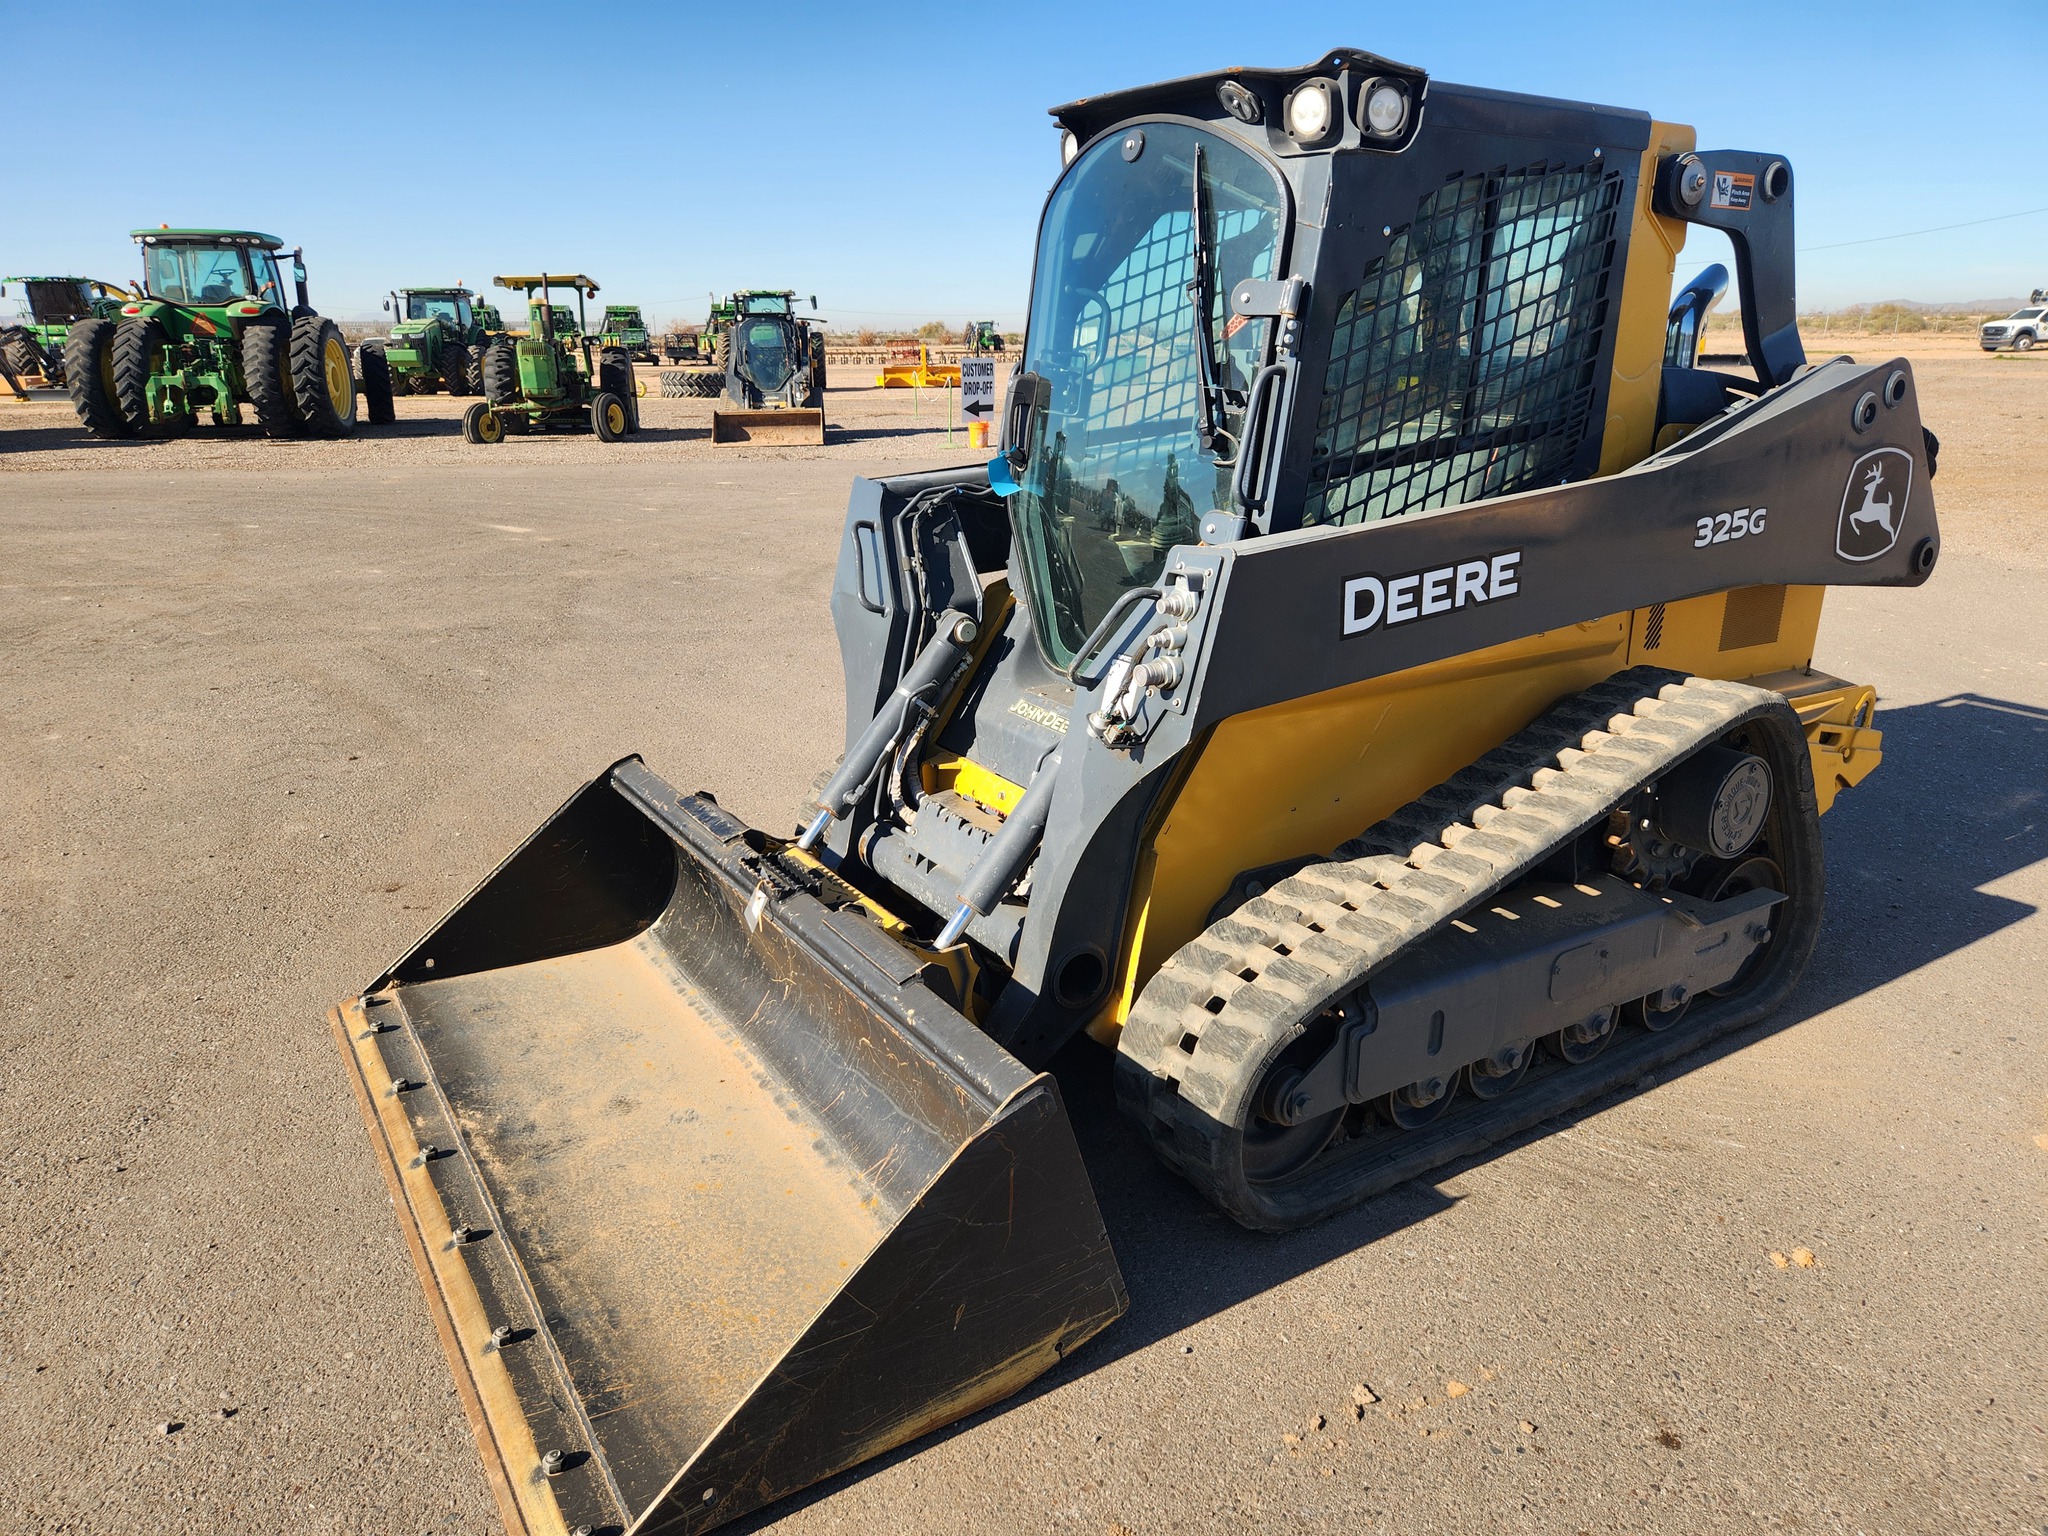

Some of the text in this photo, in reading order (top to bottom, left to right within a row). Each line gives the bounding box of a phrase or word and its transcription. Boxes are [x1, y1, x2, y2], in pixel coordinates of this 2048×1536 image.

[962, 362, 994, 377] CUSTOMER
[964, 381, 993, 395] DROP-OFF
[1694, 508, 1767, 548] 325G
[1343, 551, 1521, 635] DEERE
[1008, 699, 1070, 734] JOHN DEE
